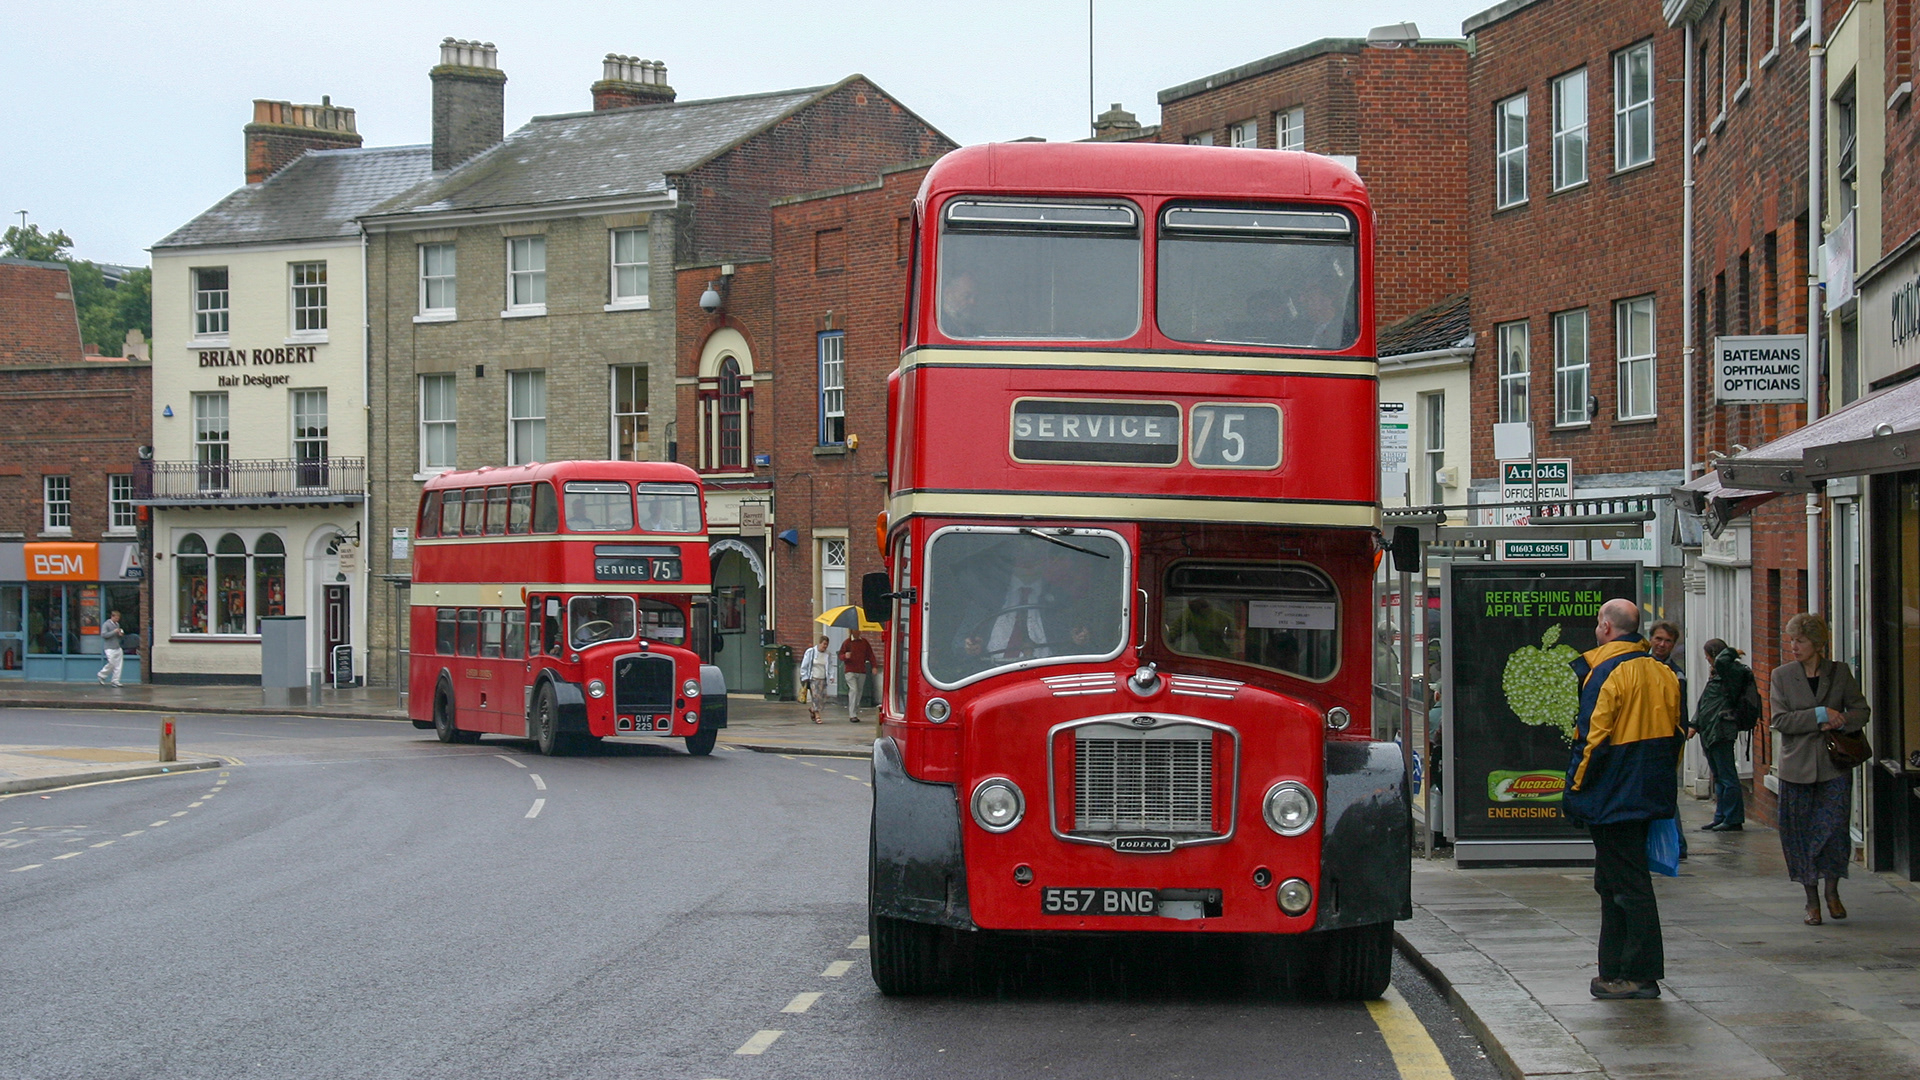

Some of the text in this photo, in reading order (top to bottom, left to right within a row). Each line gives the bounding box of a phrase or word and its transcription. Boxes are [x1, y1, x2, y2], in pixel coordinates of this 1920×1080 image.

[198, 346, 317, 367] BRIAN ROBERT
[1723, 349, 1800, 361] BATEMANS
[1723, 364, 1800, 375] OPHTHALMIC
[218, 373, 290, 388] Hair Designer
[1724, 378, 1800, 391] OPTICIANS
[1015, 409, 1245, 463] SERVICE 75
[1505, 488, 1567, 498] OFFICE RETAIL
[33, 554, 84, 575] BSM
[132, 555, 138, 565] L
[127, 569, 142, 577] BSM
[596, 561, 671, 579] SERVICE 75
[1485, 590, 1602, 603] REFRESHING NEW
[1485, 604, 1601, 617] APPLE FLAVOUR
[635, 714, 653, 723] OVF
[635, 722, 653, 731] 229
[1488, 807, 1557, 818] ENERGISING
[1046, 890, 1154, 913] 557 BNG
